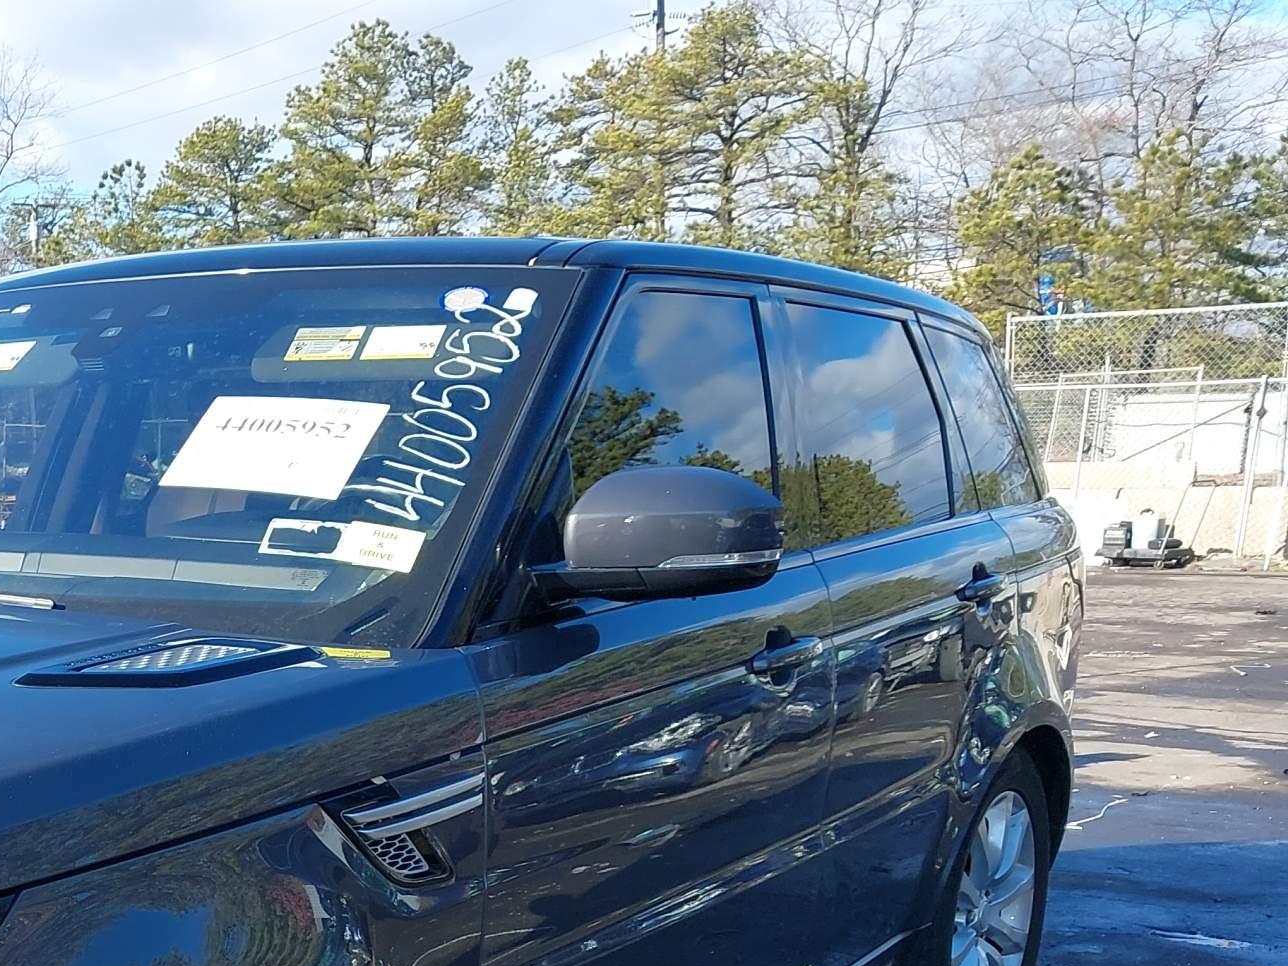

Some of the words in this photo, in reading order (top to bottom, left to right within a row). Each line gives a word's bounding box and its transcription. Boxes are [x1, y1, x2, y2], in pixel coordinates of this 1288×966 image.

[365, 303, 532, 521] 44005952
[216, 416, 352, 439] 44005952
[372, 529, 400, 541] RUN
[359, 548, 394, 562] DRIVE
